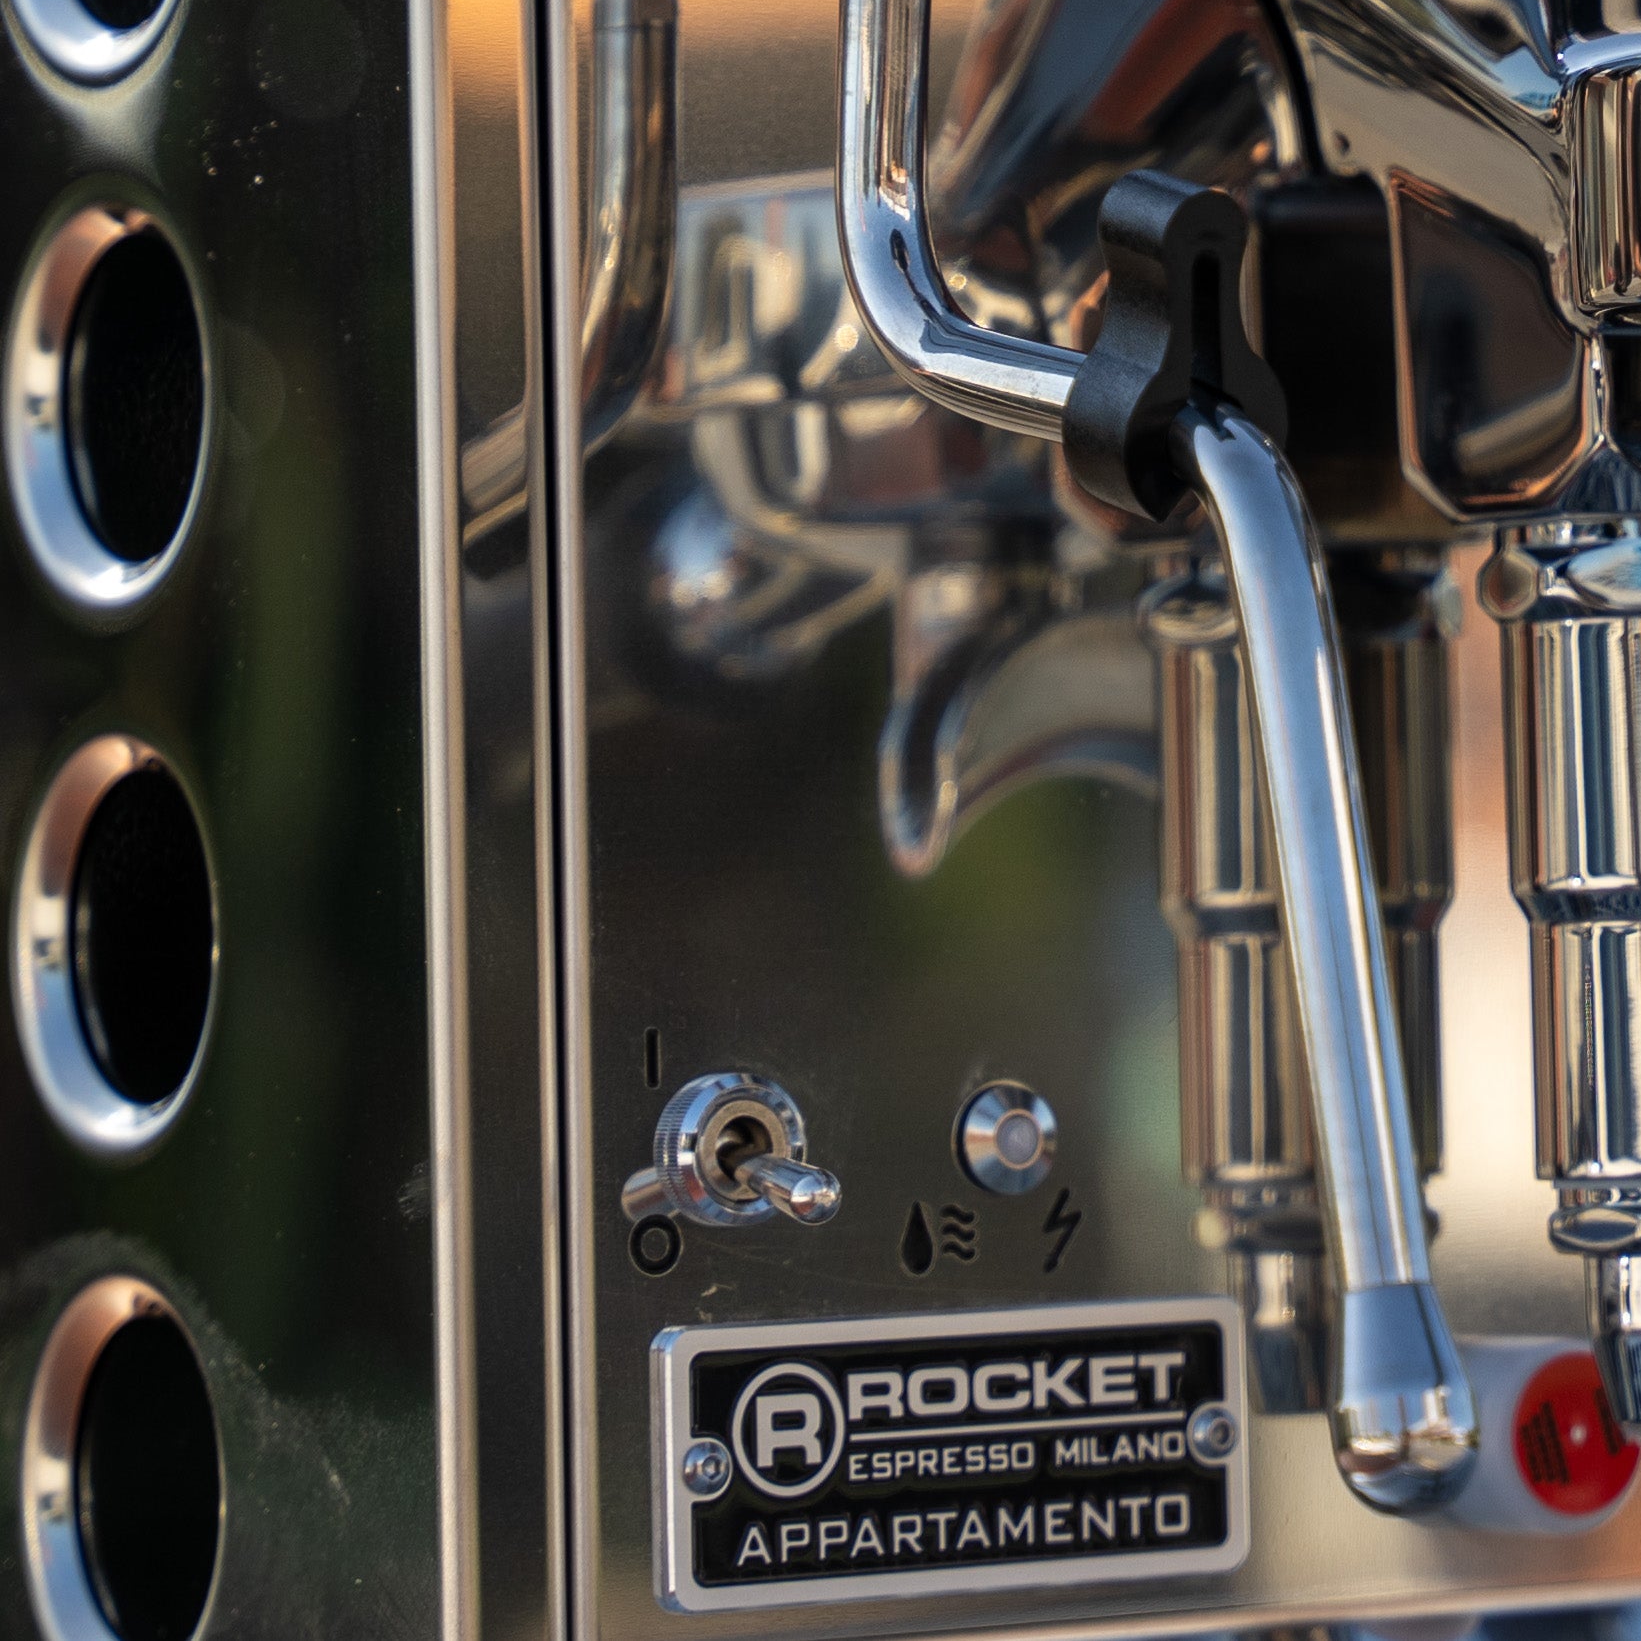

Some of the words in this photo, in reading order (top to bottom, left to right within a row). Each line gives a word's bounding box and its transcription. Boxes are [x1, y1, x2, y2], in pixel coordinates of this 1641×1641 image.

[848, 1352, 1186, 1422] ROCKET
[849, 1440, 1035, 1481] ESPRESSO
[1055, 1430, 1186, 1465] MILANO
[738, 1492, 1192, 1567] APPARTAMENTO
